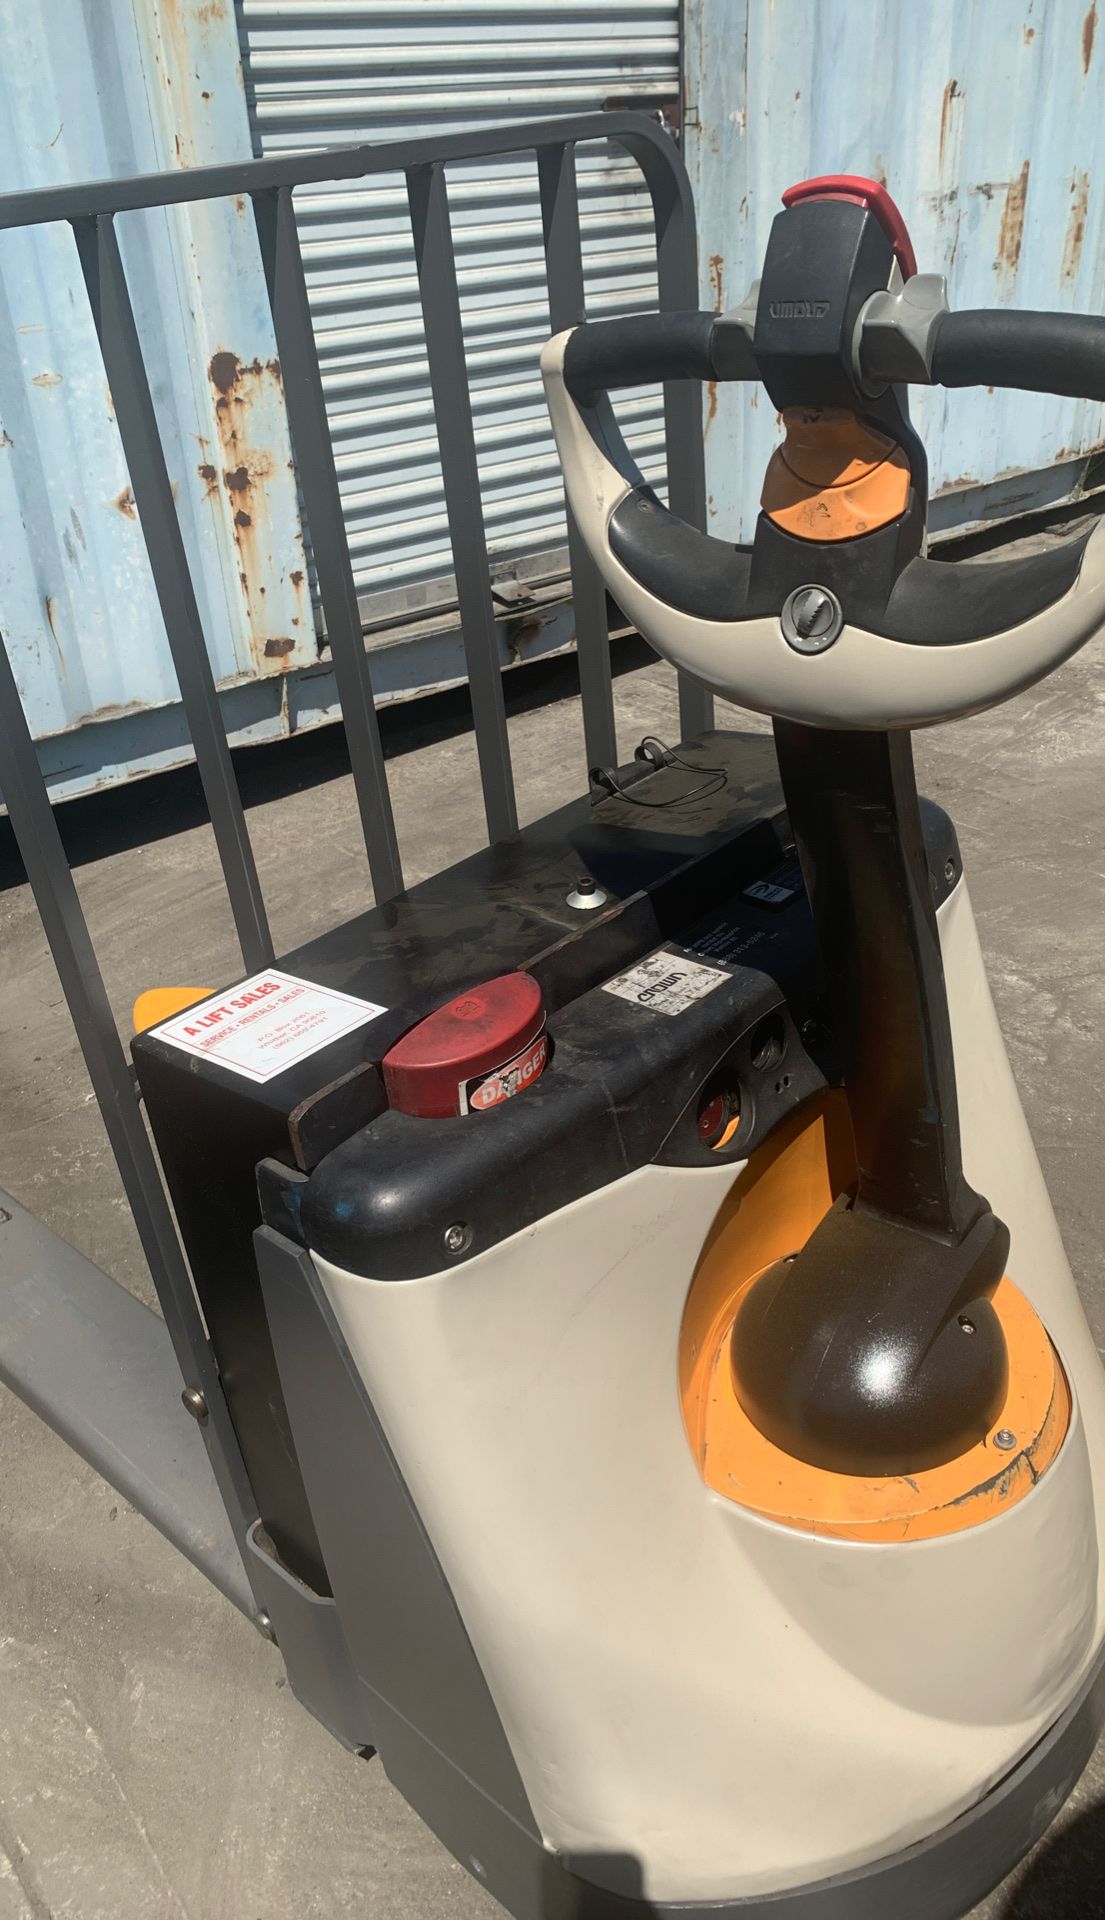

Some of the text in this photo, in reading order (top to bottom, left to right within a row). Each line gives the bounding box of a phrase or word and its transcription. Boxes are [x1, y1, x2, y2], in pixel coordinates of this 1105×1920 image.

[183, 982, 281, 1037] A LIFT SALES
[200, 988, 305, 1048] SERVICE RENTALS SALES
